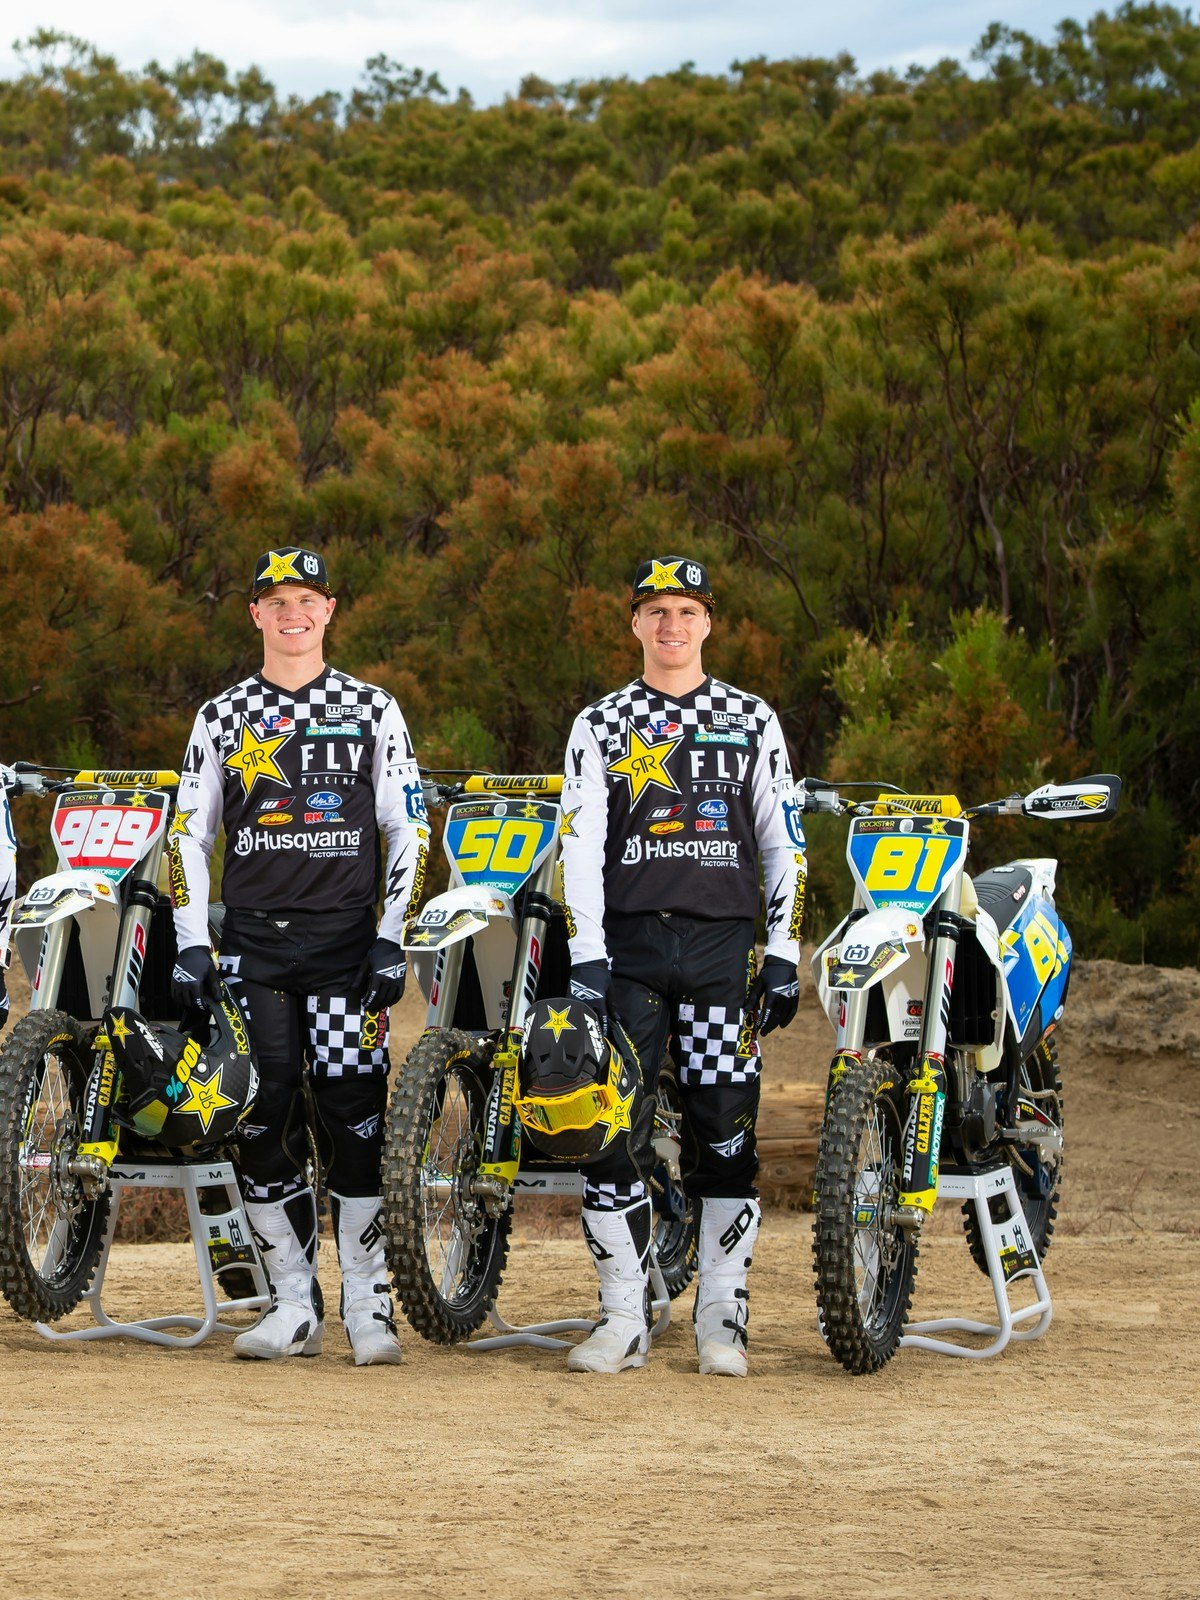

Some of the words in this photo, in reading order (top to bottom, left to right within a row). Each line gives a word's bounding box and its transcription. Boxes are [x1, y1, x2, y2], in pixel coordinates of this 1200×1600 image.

[327, 704, 363, 716] WPS
[260, 714, 282, 730] VP
[647, 719, 669, 734] VP
[714, 712, 749, 726] WPS
[319, 725, 360, 736] MOTOREX
[708, 734, 748, 746] MOTOREX
[300, 743, 364, 772] FLY
[689, 750, 751, 781] FLY
[301, 775, 356, 786] RACING
[64, 794, 99, 803] ROCKSTAR
[1051, 800, 1085, 809] CYCRA
[456, 805, 490, 814] ROCKSTAR
[60, 809, 153, 859] 989
[255, 831, 361, 851] Husqvarna
[456, 819, 544, 874] 50
[700, 860, 729, 868] FACTORY
[865, 836, 950, 893] 81
[480, 882, 515, 890] MOTOREX
[888, 900, 924, 910] MOTOREX
[83, 1059, 102, 1132] DUNLO
[499, 1067, 516, 1126] GALFER
[485, 1079, 500, 1152] DUNLO
[916, 1094, 935, 1154] GALFER
[930, 1096, 945, 1163] MOTOREX
[857, 1211, 872, 1222] 81
